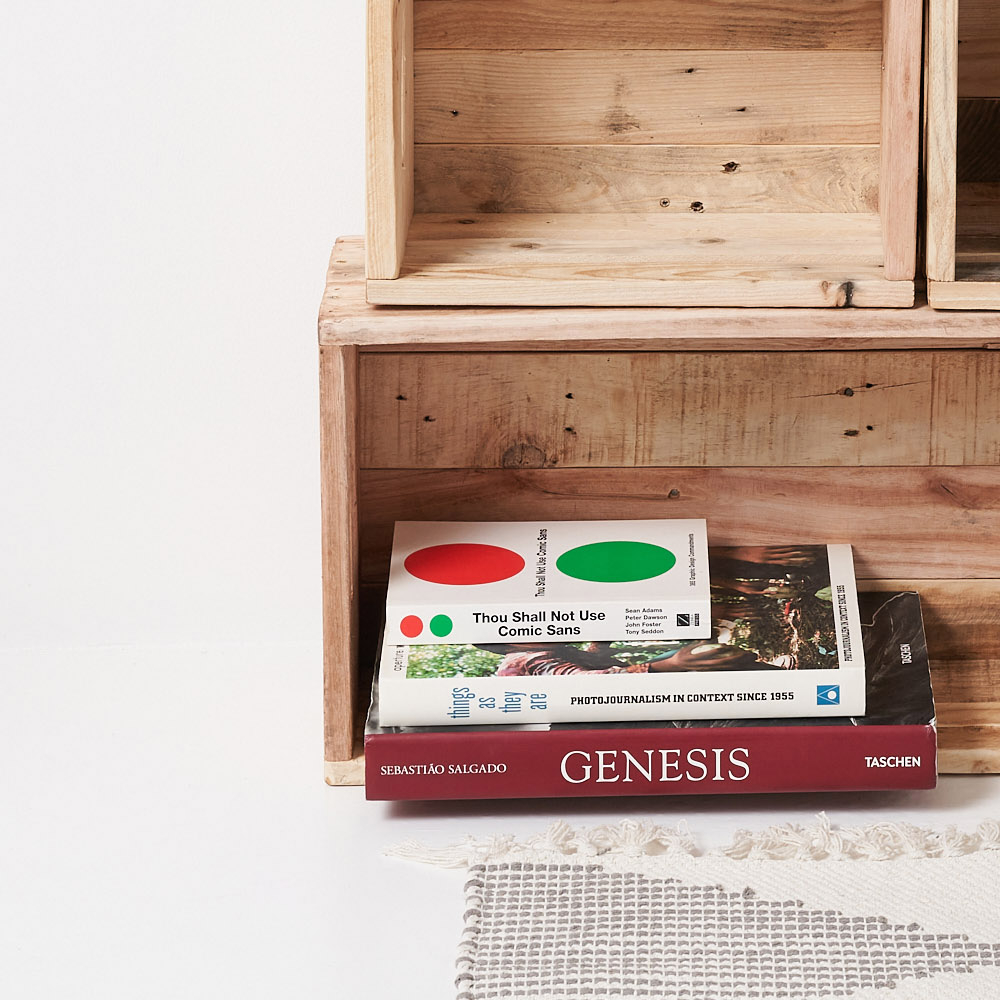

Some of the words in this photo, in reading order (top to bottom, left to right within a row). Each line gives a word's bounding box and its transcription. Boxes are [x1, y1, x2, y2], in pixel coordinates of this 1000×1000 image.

[537, 529, 548, 541] Sans
[536, 542, 547, 556] Comic
[536, 557, 547, 566] Use
[535, 576, 546, 586] Shall
[535, 587, 545, 597] Thou
[838, 594, 847, 605] SINCE
[472, 612, 508, 623] Thou
[512, 611, 546, 623] Shall
[551, 610, 575, 622] Not
[579, 610, 606, 621] Use
[840, 605, 849, 621] CONTEXT
[498, 625, 542, 637] Comic
[546, 624, 581, 636] Sans
[843, 626, 853, 662] PHOTOJOURNALISM
[901, 643, 912, 665] TASCHEN
[447, 687, 475, 719] things
[479, 697, 496, 709] as
[498, 691, 527, 713] they
[530, 693, 547, 710] are
[570, 694, 671, 705] PHOTOJOURNALISM
[673, 694, 685, 703] IN
[687, 693, 735, 703] CONTEXT
[736, 692, 767, 701] SINCE
[770, 691, 794, 701] 1955
[448, 763, 507, 774] SALGADO
[560, 747, 750, 784] GENESIS
[864, 756, 921, 768] TASCHEN
